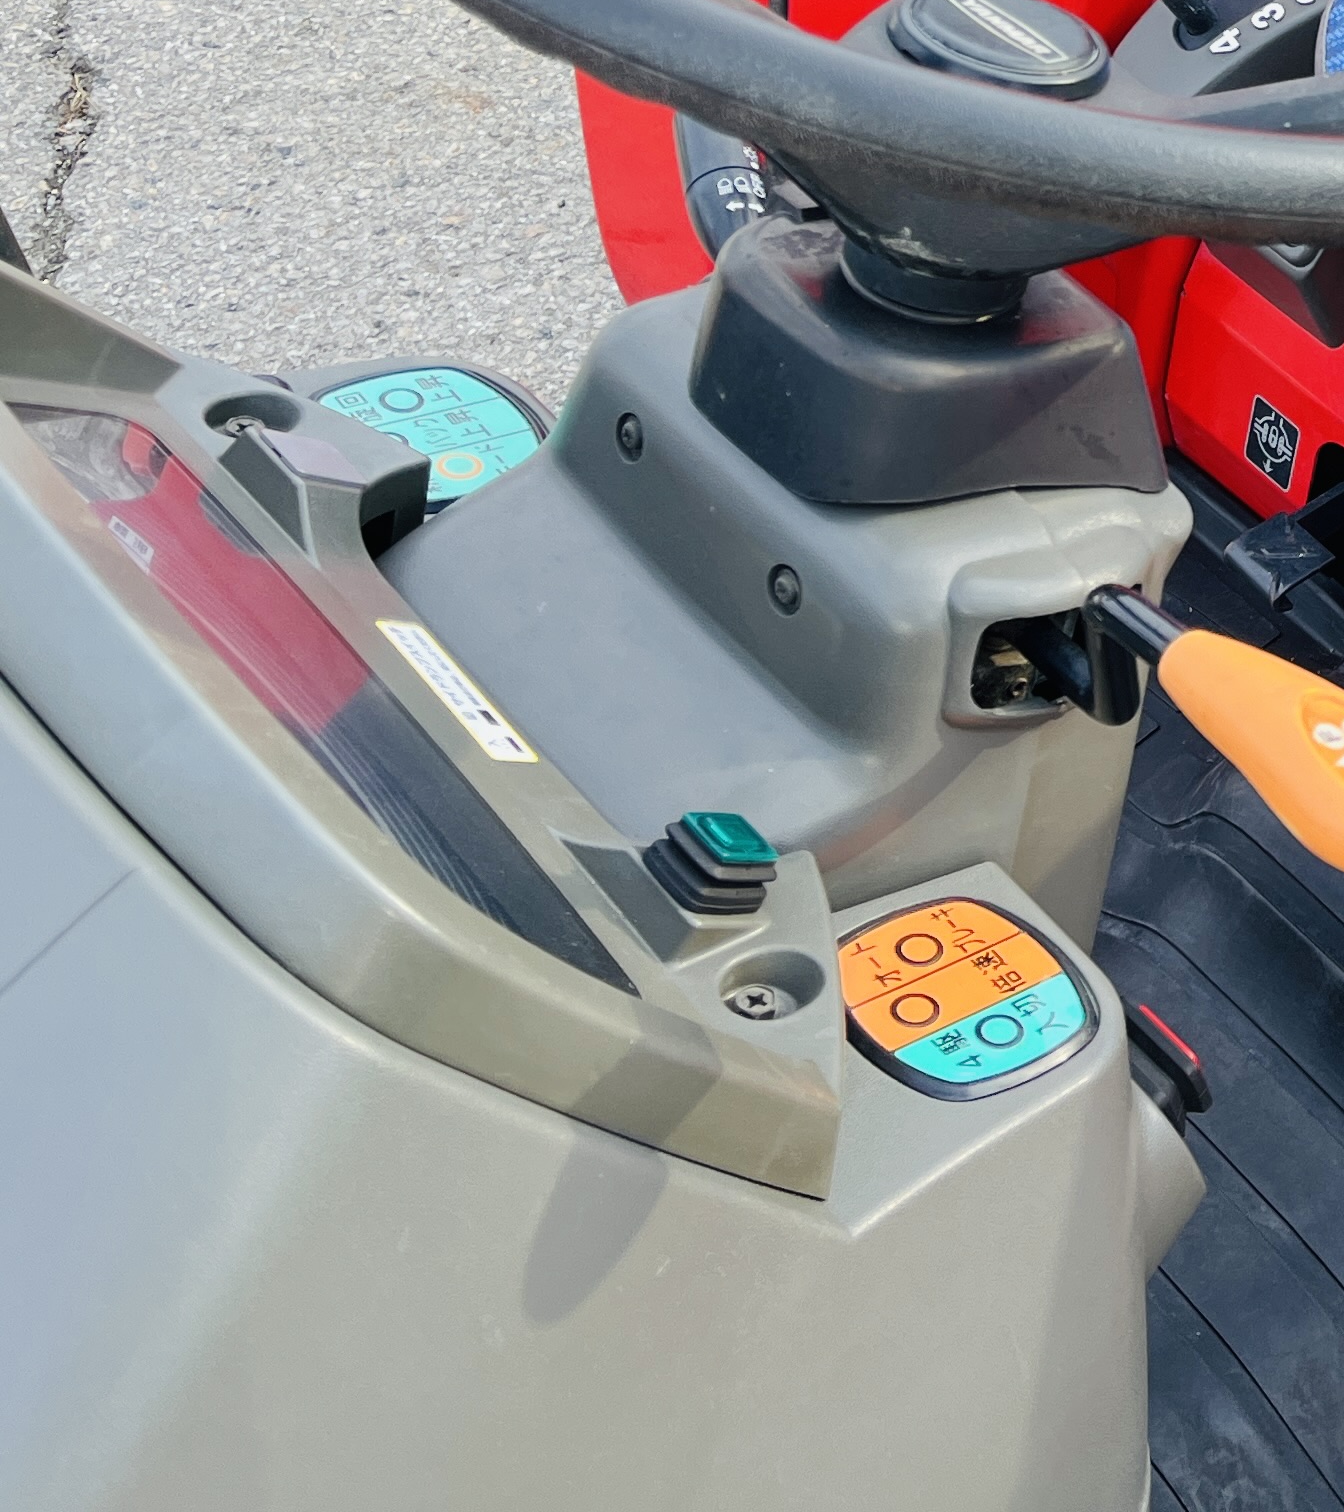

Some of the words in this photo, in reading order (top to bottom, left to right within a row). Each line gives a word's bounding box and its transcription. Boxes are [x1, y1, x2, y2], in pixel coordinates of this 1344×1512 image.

[1208, 26, 1243, 55] 4
[1249, 2, 1286, 31] 3
[414, 373, 463, 403] 上昇
[413, 416, 458, 449] バック
[443, 408, 492, 438] 上昇
[929, 907, 988, 954] ブレーキ
[849, 941, 903, 989] オート
[969, 948, 1028, 995] 倍速
[929, 1027, 984, 1069] 4駆
